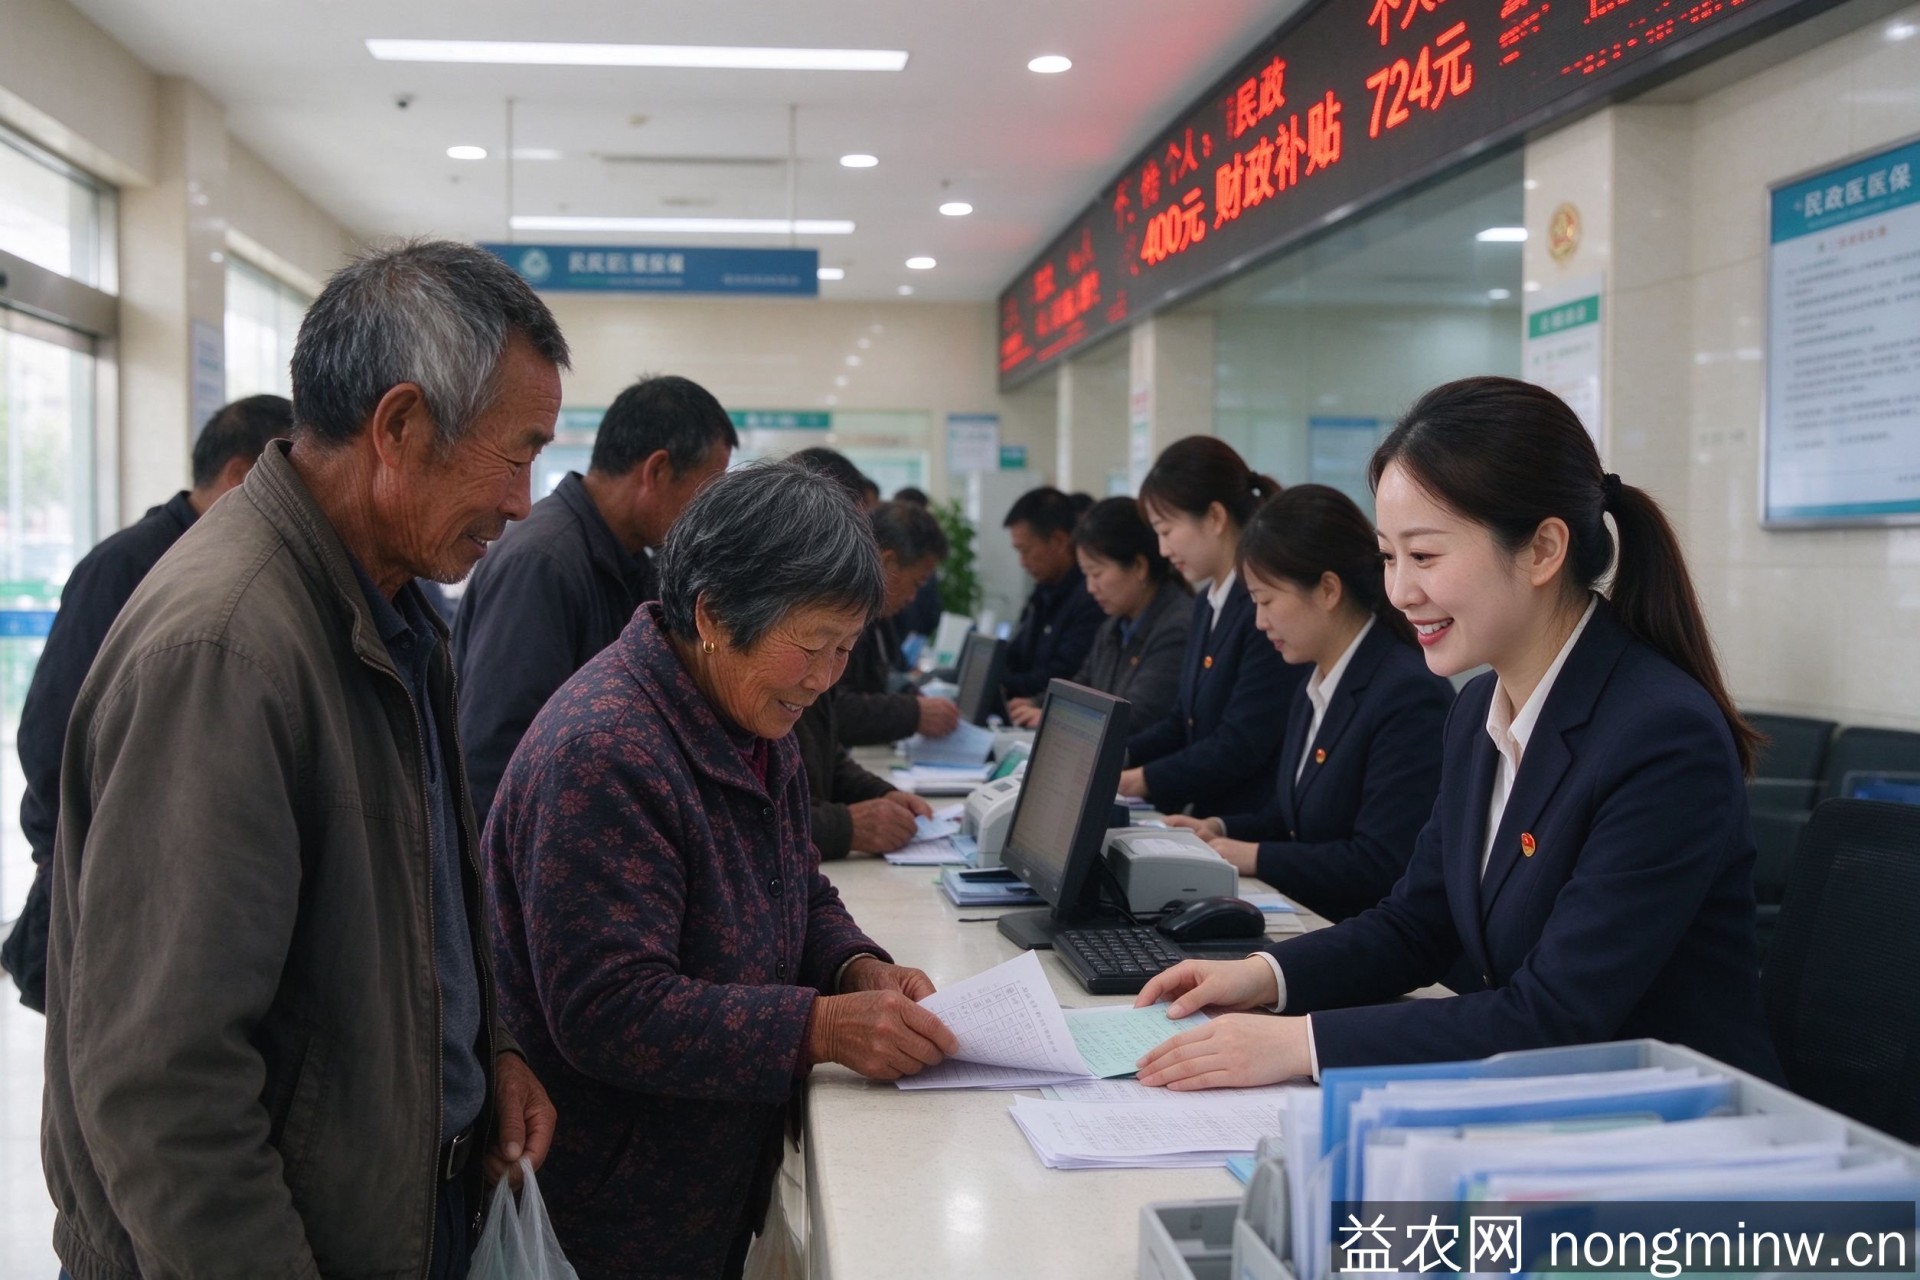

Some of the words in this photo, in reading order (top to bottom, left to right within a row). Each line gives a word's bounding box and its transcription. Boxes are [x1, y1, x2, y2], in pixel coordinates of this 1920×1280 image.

[1141, 187, 1206, 266] 400元
[1213, 90, 1342, 230] 财政补贴
[1366, 21, 1472, 138] 724元
